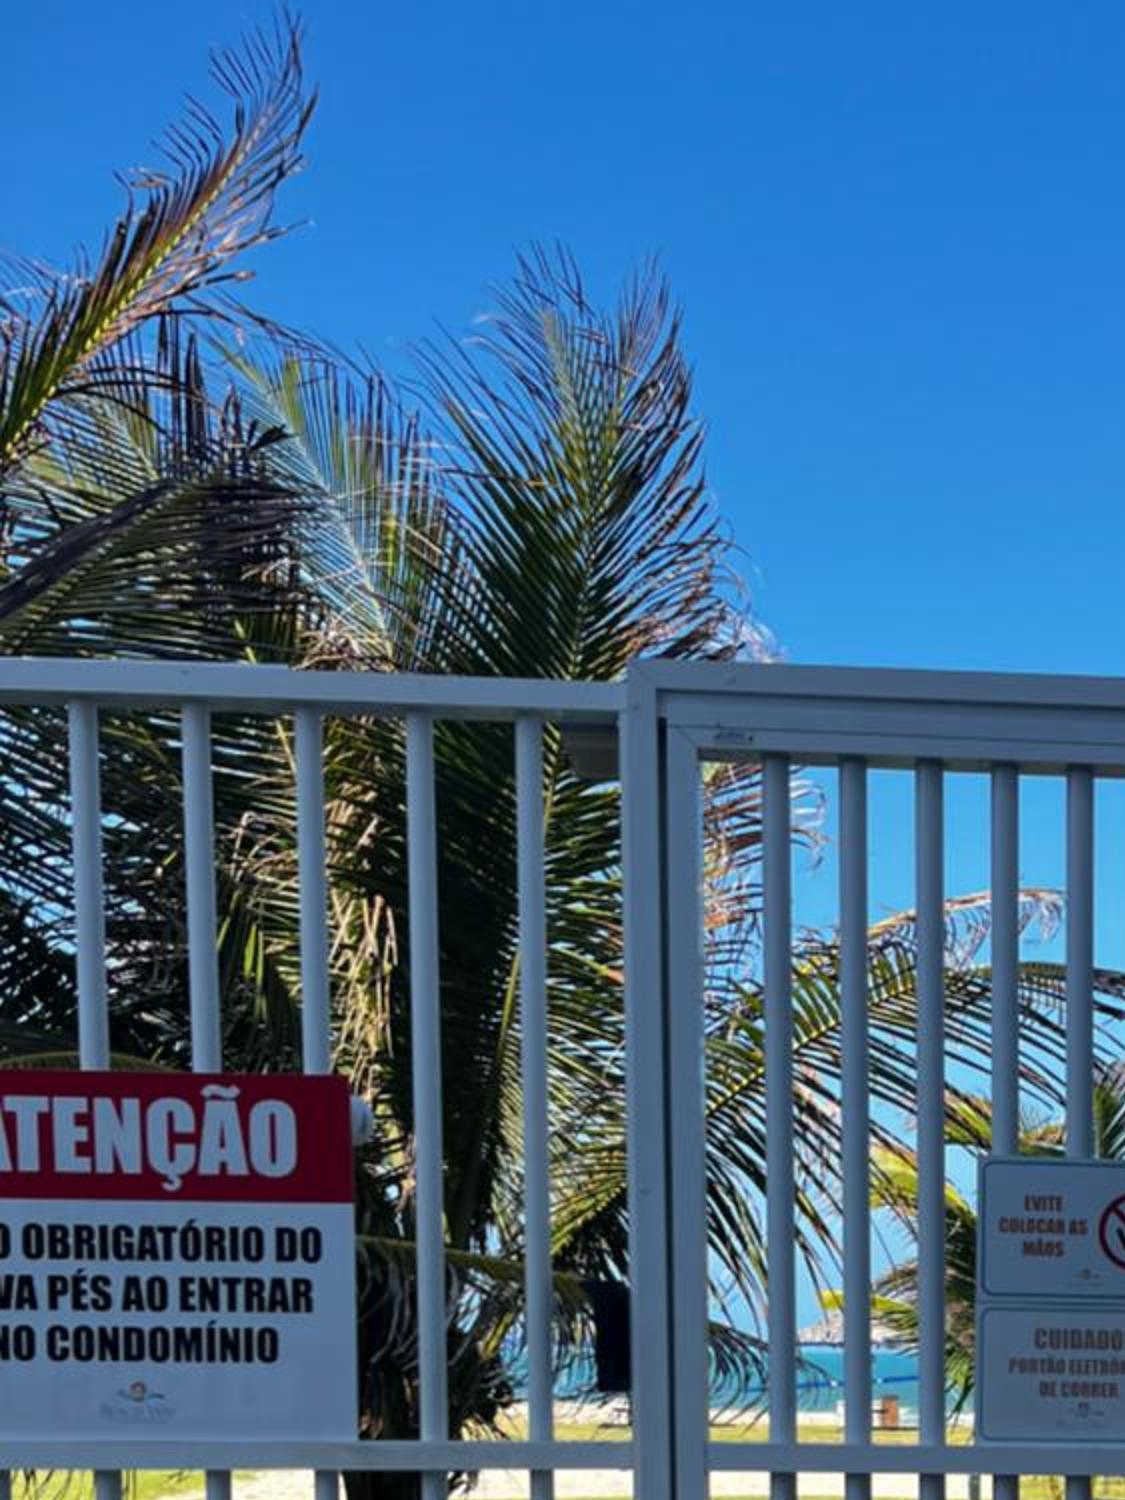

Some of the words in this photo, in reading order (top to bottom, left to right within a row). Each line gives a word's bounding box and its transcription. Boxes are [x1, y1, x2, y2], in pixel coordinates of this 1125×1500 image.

[0, 1084, 298, 1192] TENÇÃO
[1023, 1195, 1064, 1212] EVITE
[998, 1217, 1065, 1235] COLOCAR
[1068, 1219, 1088, 1236] AS
[21, 1218, 265, 1263] OBRIGATÓRIO
[275, 1226, 323, 1264] DO
[1022, 1239, 1065, 1258] MÃOS
[47, 1268, 113, 1313] PÉS
[121, 1275, 169, 1313] AO
[178, 1276, 314, 1314] ENTRAR
[46, 1319, 280, 1364] CONDOMÍNIO
[1008, 1356, 1066, 1375] PORTÃO
[1039, 1380, 1057, 1398] DE
